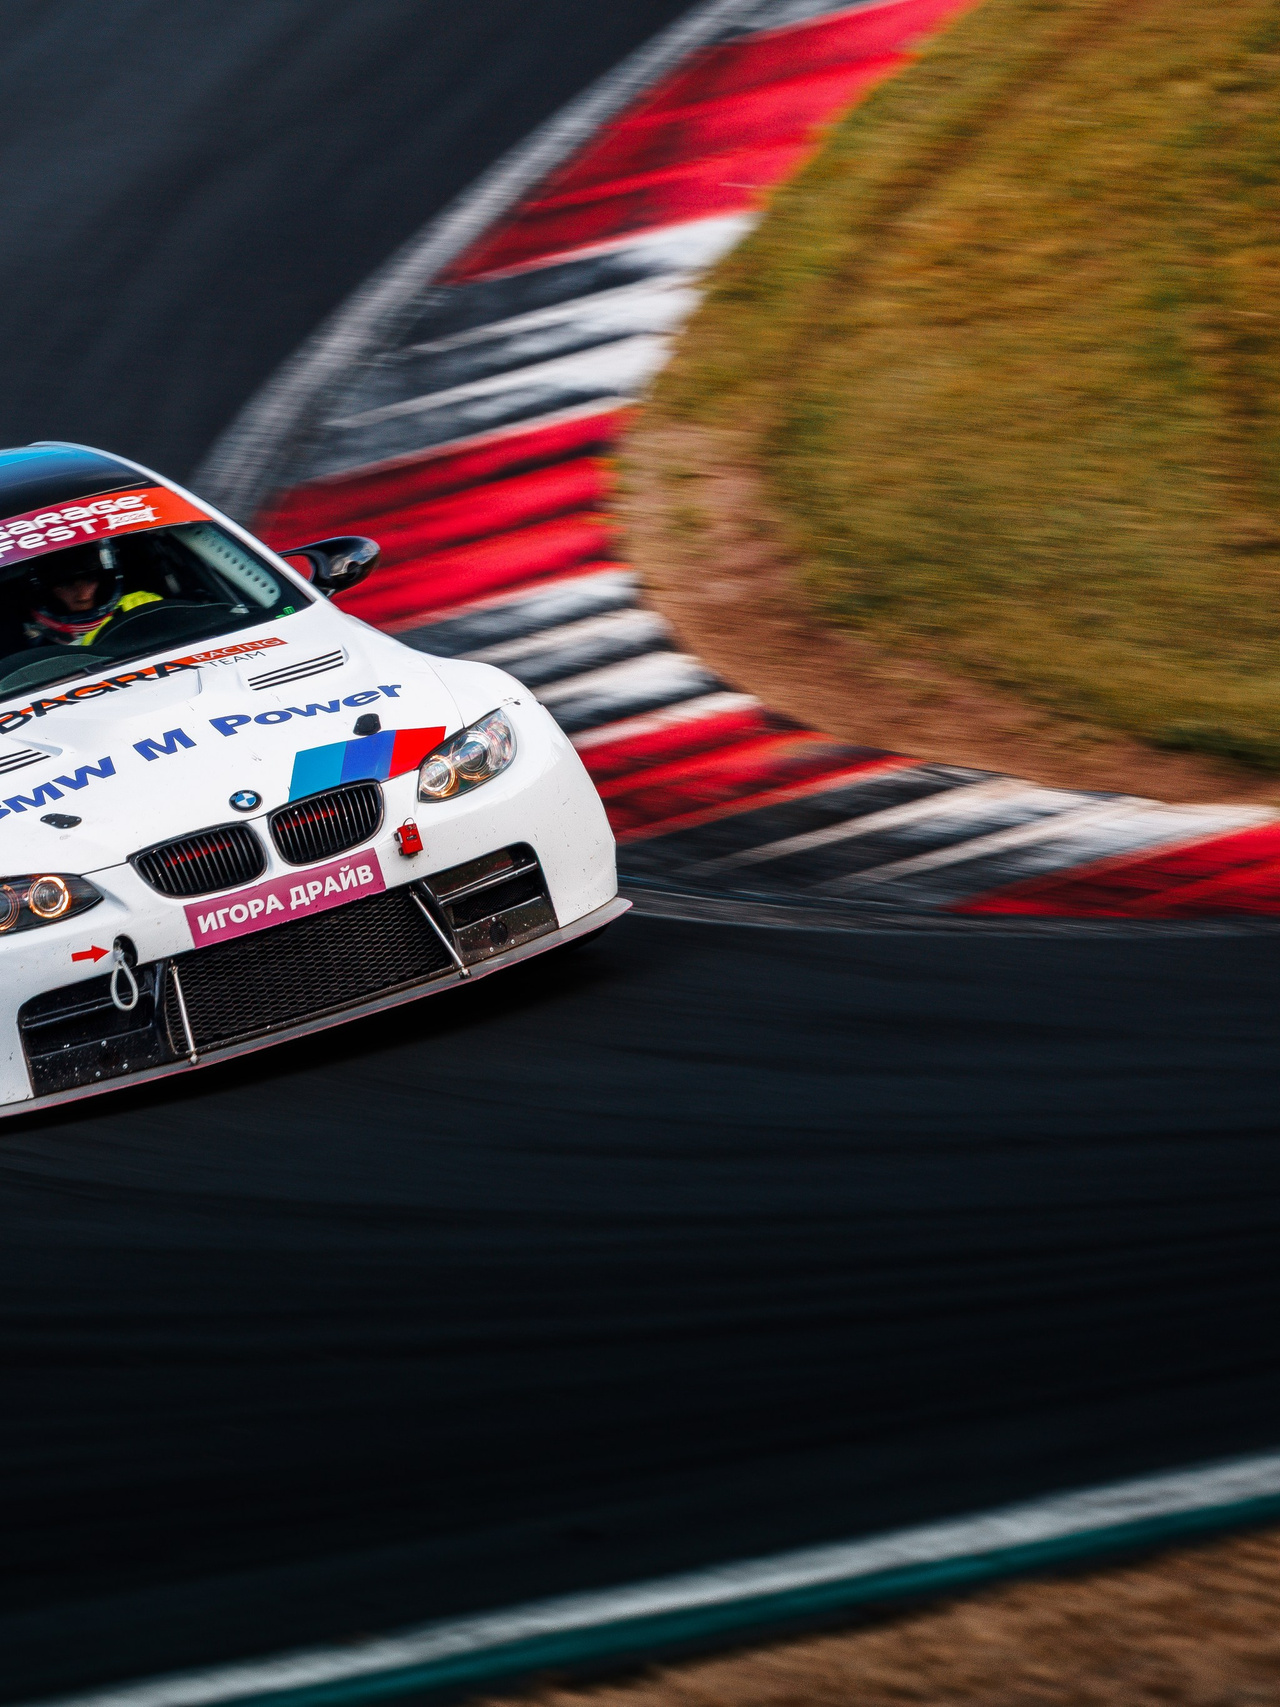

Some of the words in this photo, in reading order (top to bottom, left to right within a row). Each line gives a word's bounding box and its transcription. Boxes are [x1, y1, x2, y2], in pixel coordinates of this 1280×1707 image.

[192, 638, 281, 661] RACING
[206, 650, 266, 668] TEAM
[133, 728, 197, 761] M
[208, 684, 402, 737] Power
[197, 894, 284, 934] ИГОРА
[289, 864, 374, 911] ДРАЙВ
